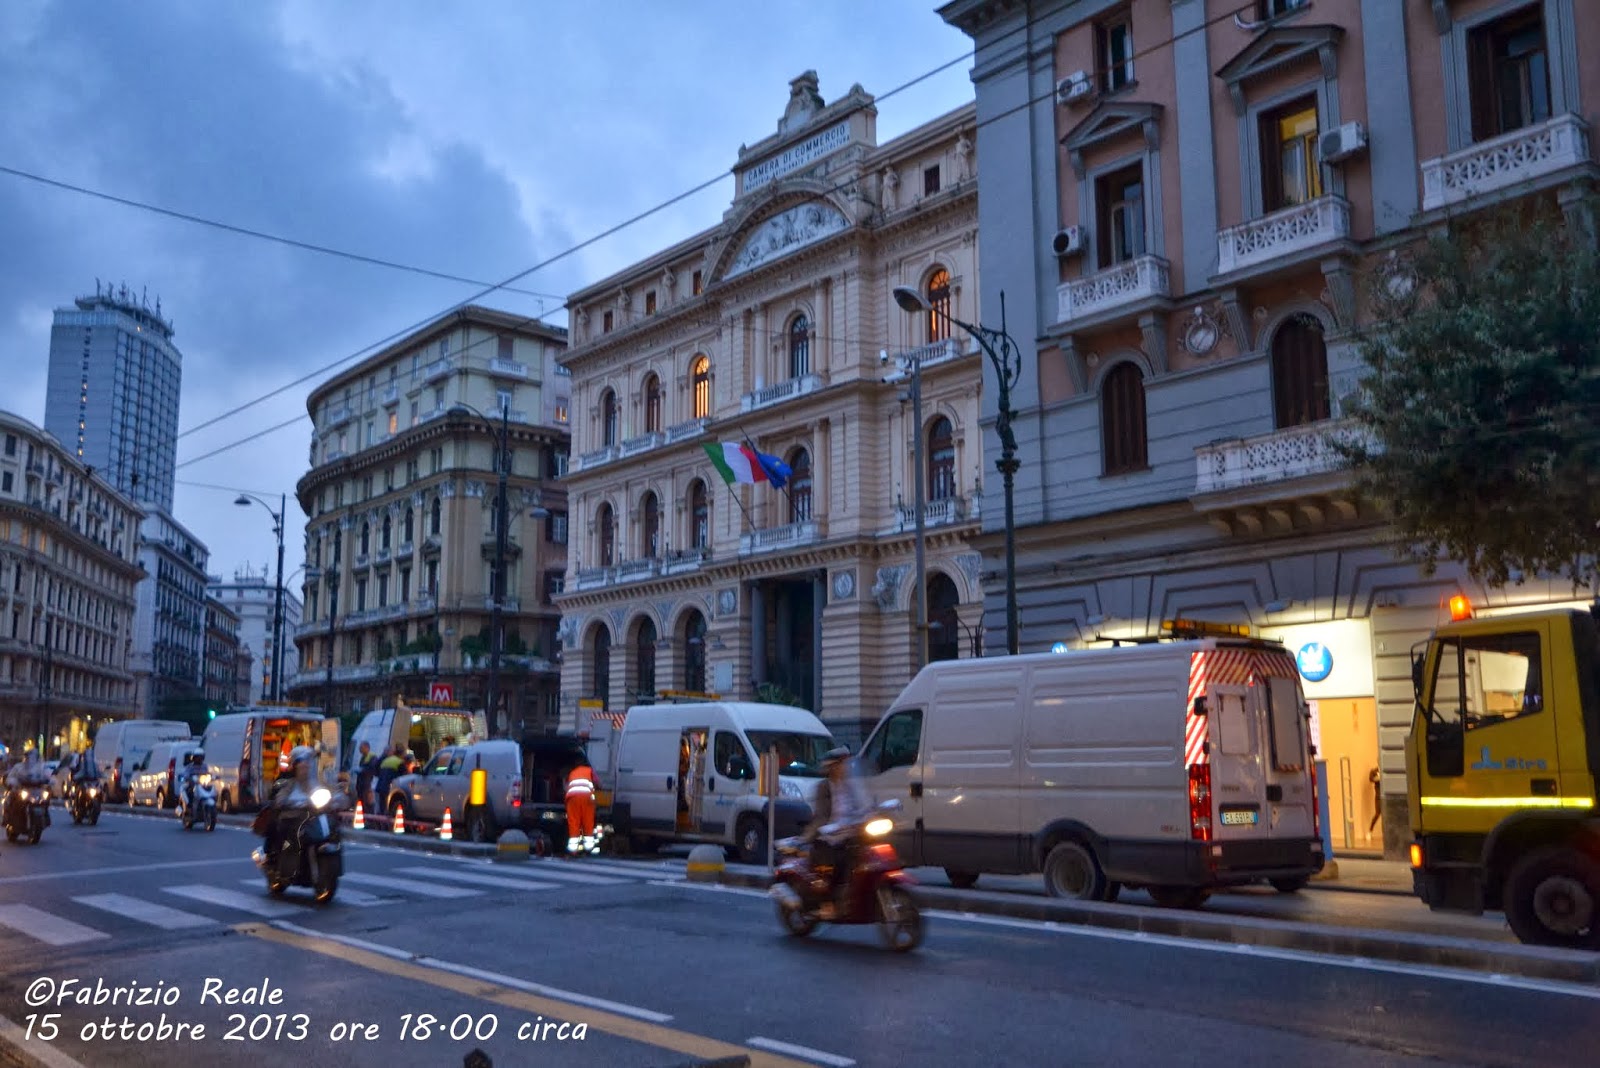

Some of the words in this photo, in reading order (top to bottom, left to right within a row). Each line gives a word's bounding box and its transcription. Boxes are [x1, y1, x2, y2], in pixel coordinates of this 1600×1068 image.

[748, 158, 780, 182] CAMERA
[783, 151, 792, 164] DI
[794, 124, 846, 159] COMMERCIO
[434, 688, 450, 702] M
